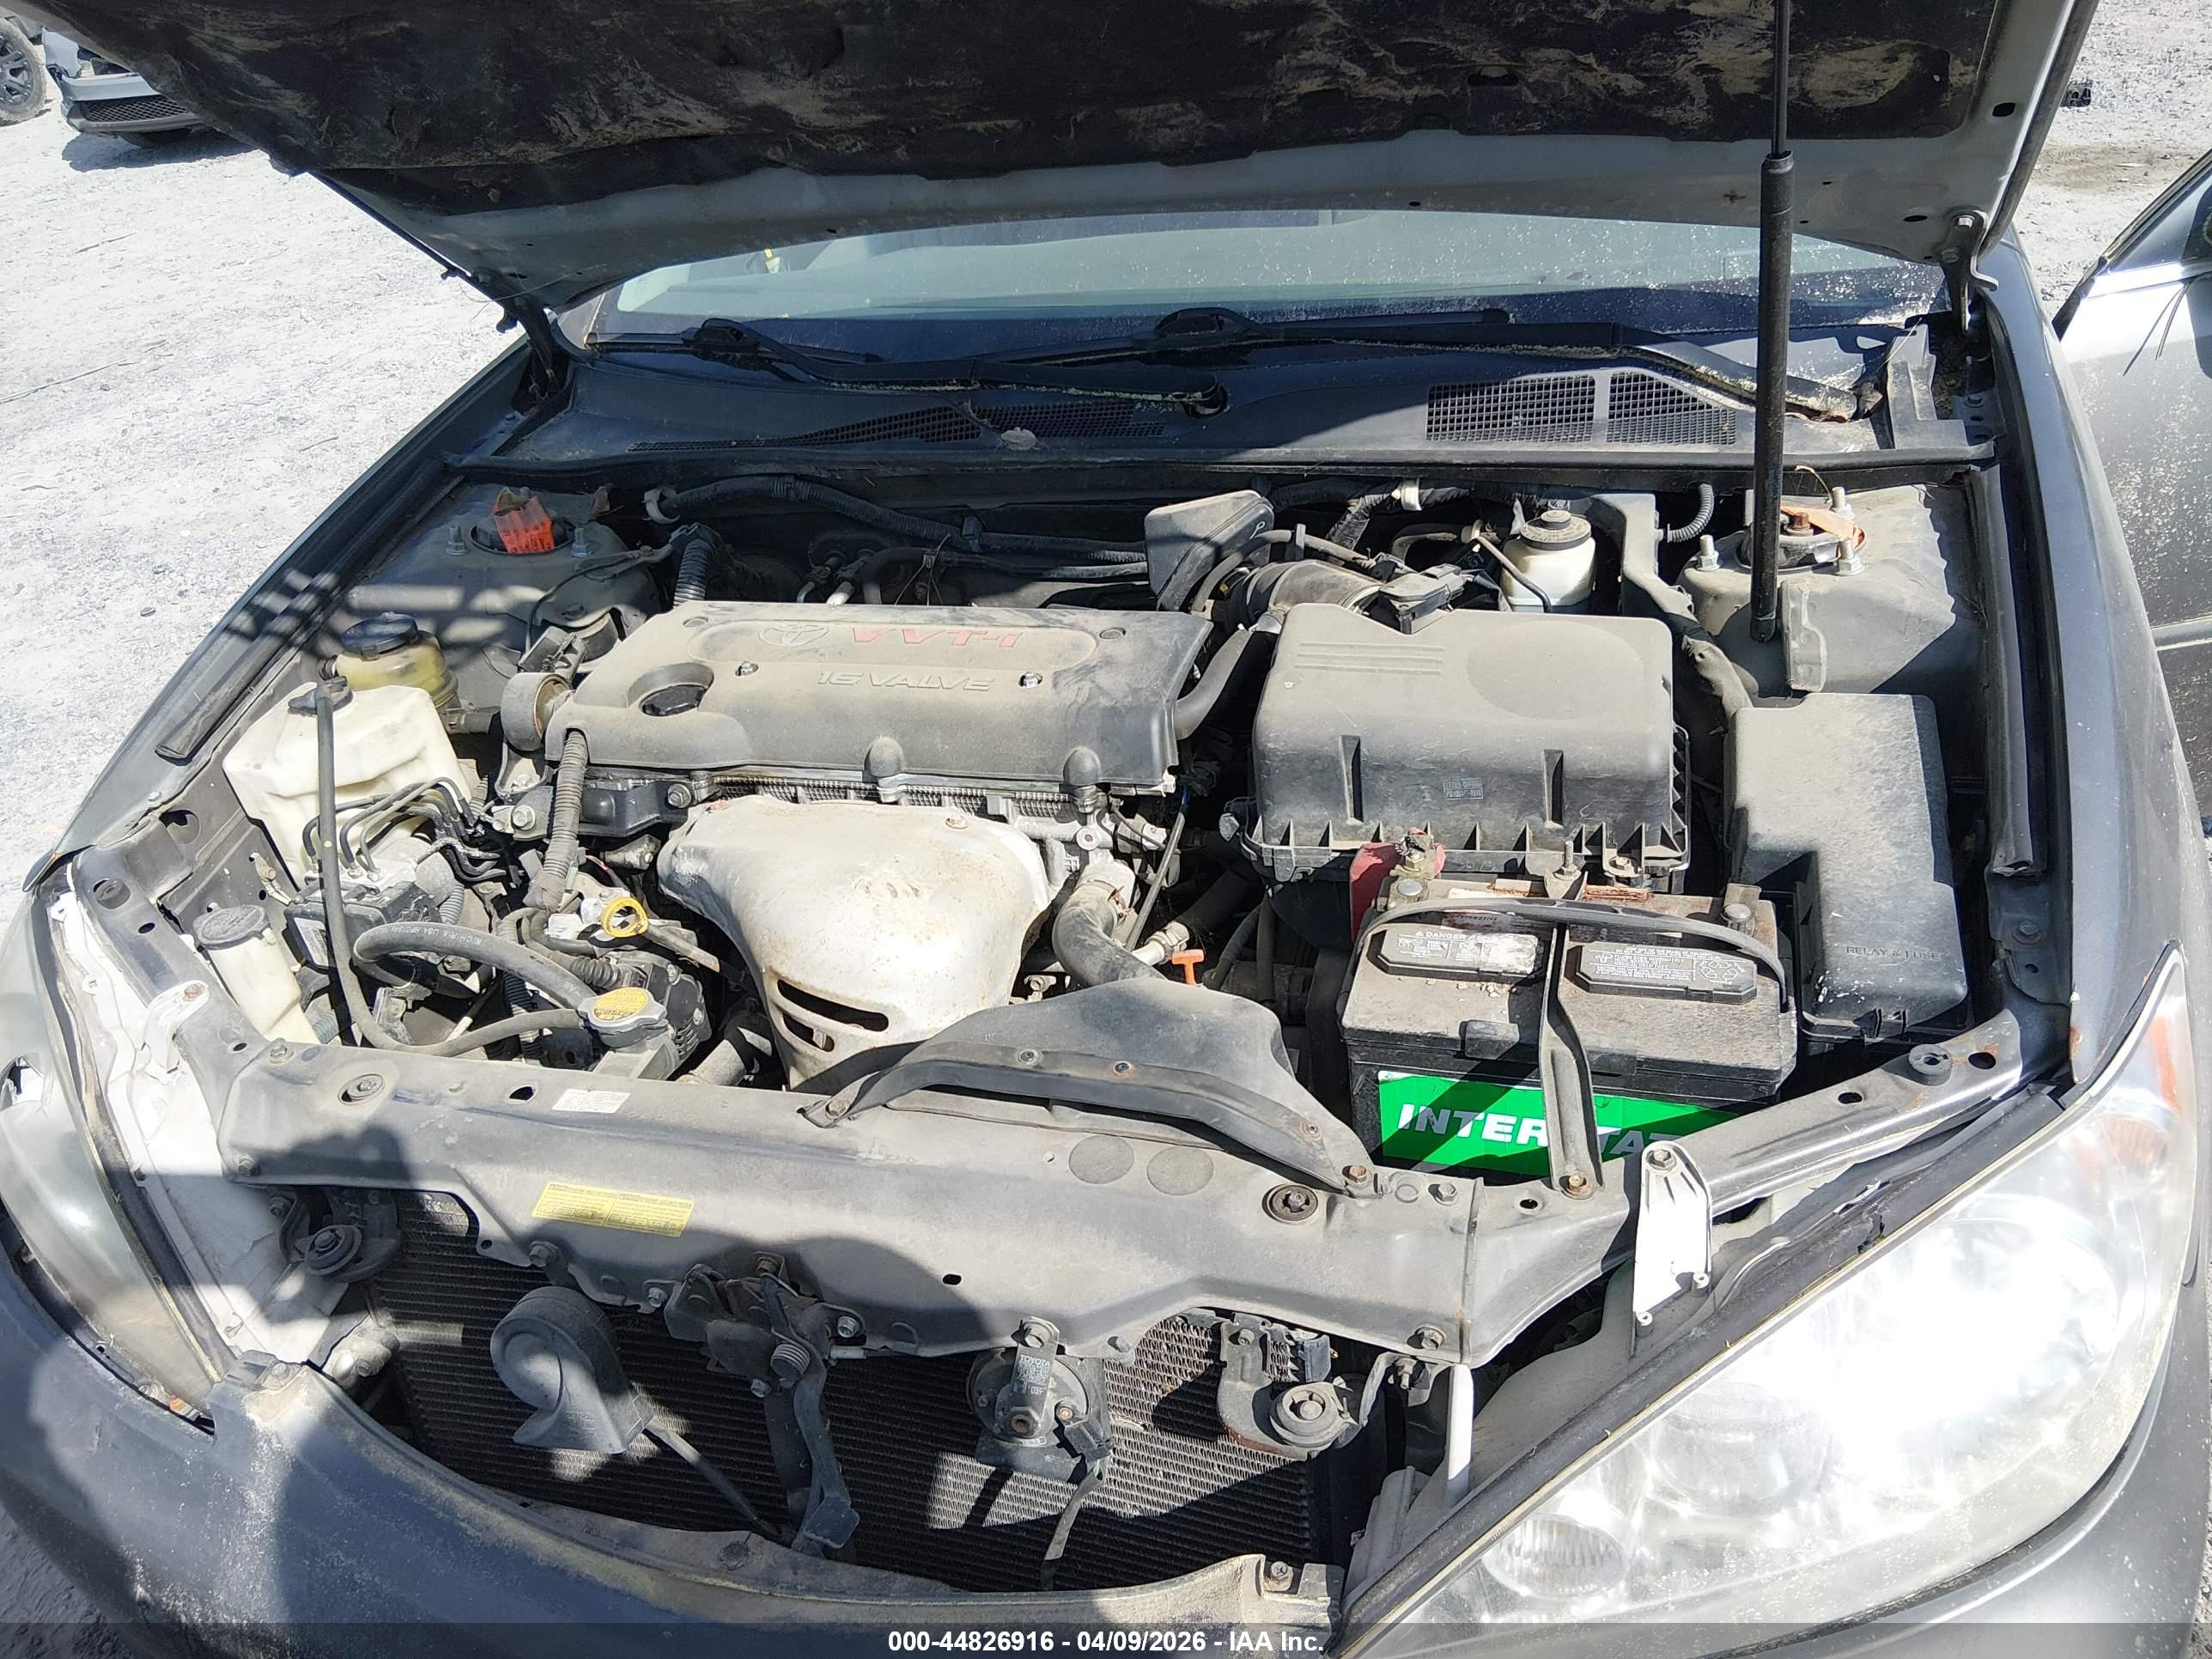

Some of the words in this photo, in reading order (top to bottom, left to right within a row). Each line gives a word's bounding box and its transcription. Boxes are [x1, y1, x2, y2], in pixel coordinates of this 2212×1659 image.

[869, 673, 996, 691] VALVE
[1425, 931, 1467, 940] DANGER
[1845, 946, 1888, 957] RELAY
[1905, 950, 1939, 960] FUSE
[1019, 1354, 1051, 1368] TOYOTA
